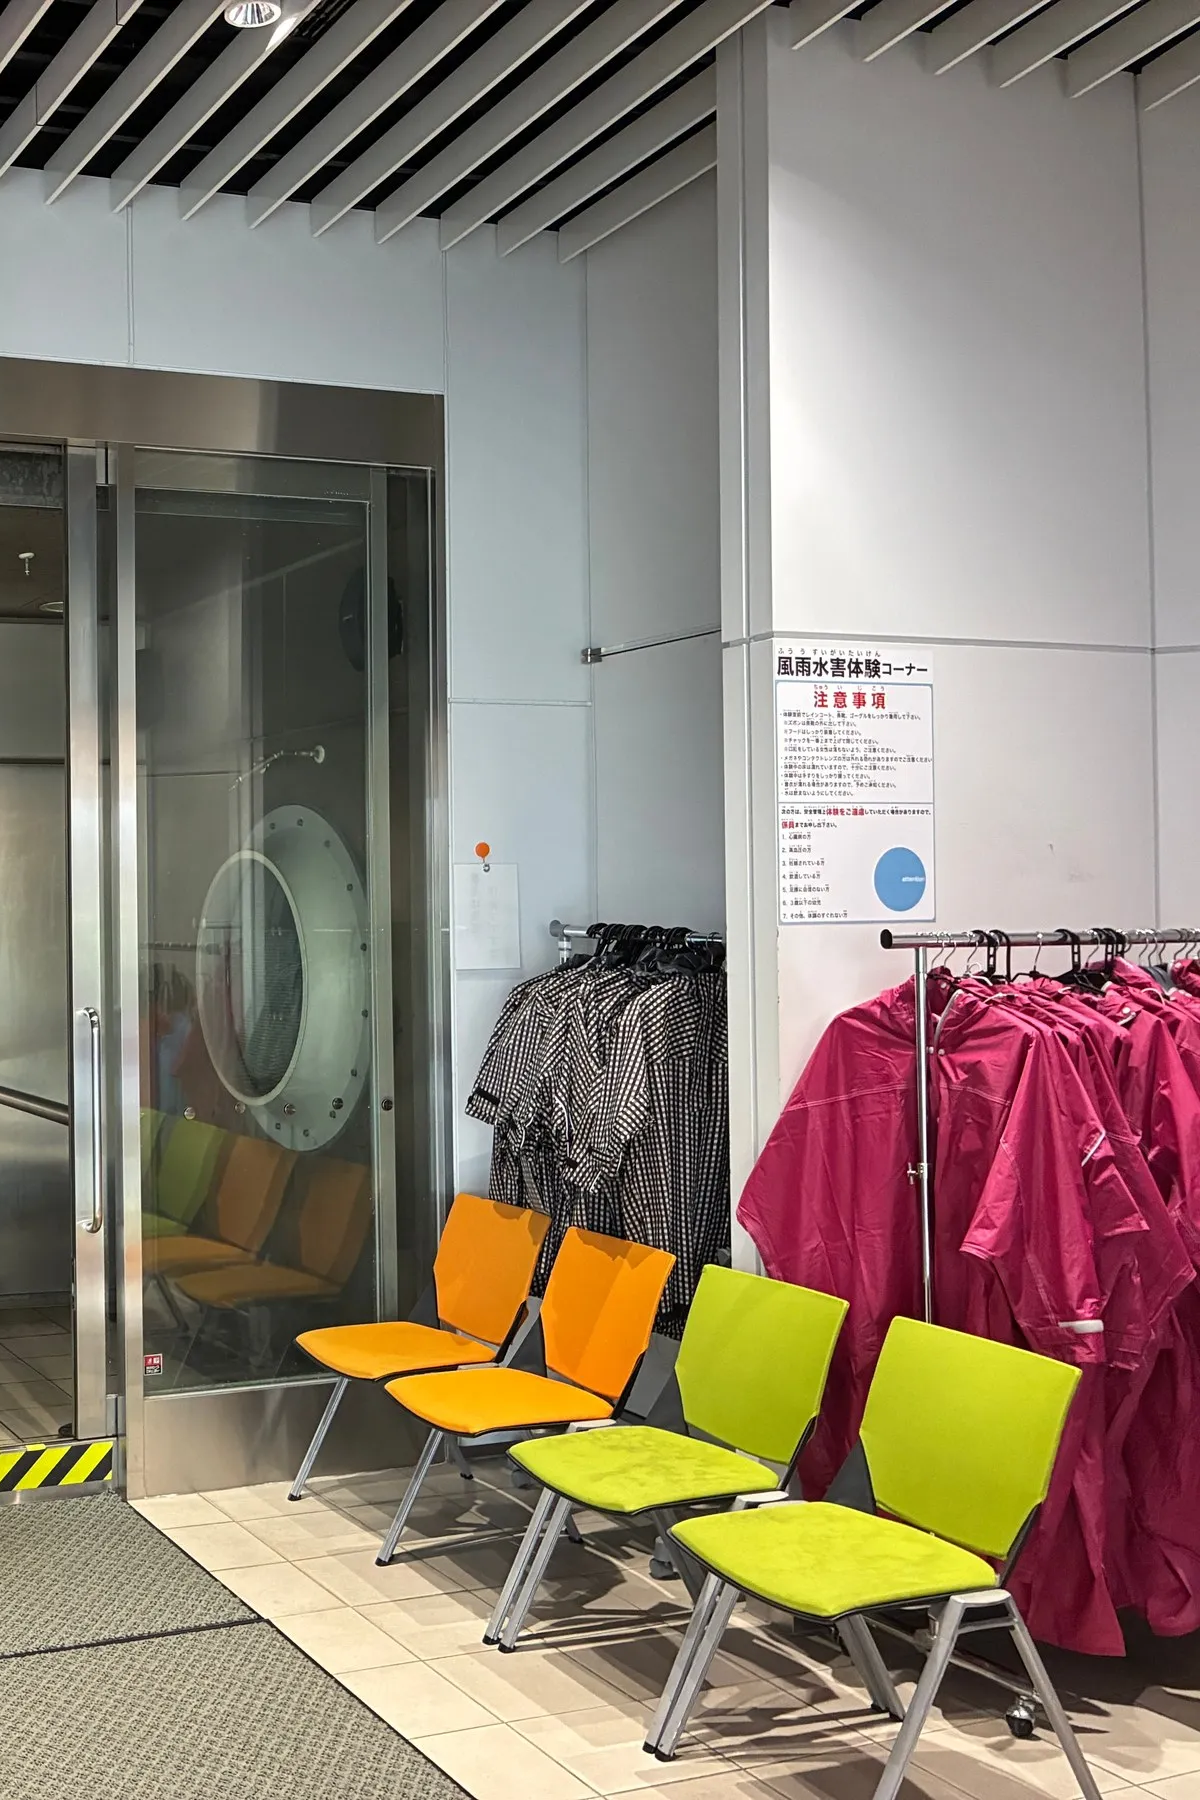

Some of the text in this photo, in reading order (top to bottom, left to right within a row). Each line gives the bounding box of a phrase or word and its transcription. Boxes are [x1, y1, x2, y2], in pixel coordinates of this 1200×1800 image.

[776, 656, 928, 679] 風雨水害体験コーナー
[813, 691, 886, 710] 注意事項
